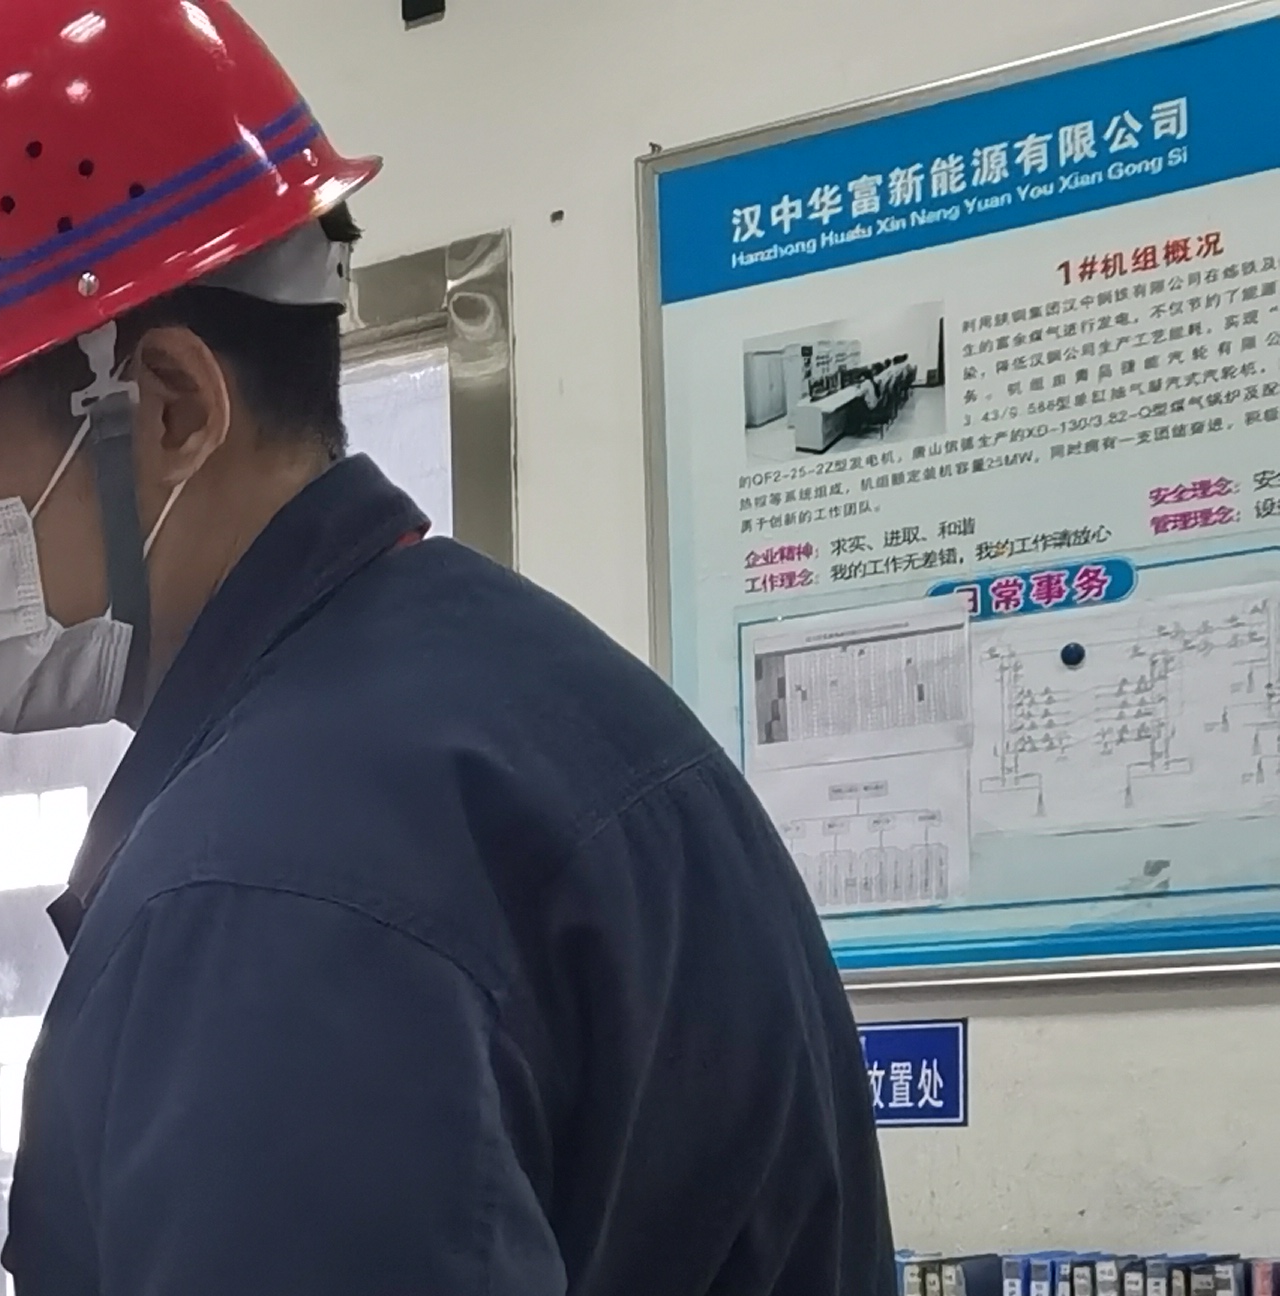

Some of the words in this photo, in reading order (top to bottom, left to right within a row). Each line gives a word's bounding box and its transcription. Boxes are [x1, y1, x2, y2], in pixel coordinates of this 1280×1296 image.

[731, 97, 1188, 243] 汉中华富新能源有限公司
[731, 236, 817, 269] Hanzhong
[876, 217, 907, 236] Xin
[963, 190, 1013, 216] Yuan
[1015, 180, 1055, 202] You
[1058, 168, 1104, 194] Xian
[1107, 155, 1164, 182] Gong
[1167, 145, 1189, 168] Si
[1056, 231, 1225, 286] 1#机组概况
[961, 255, 1280, 333] 利用陕钢集团汉中钢铁有限公司在炼铁及
[744, 541, 818, 569] 企业精神：
[830, 517, 976, 556] 求实、进取、和谐
[1254, 497, 1280, 519] 设
[744, 567, 820, 594] 工作理念：
[830, 524, 1112, 582] 我的工作无差错，我的工作请放心
